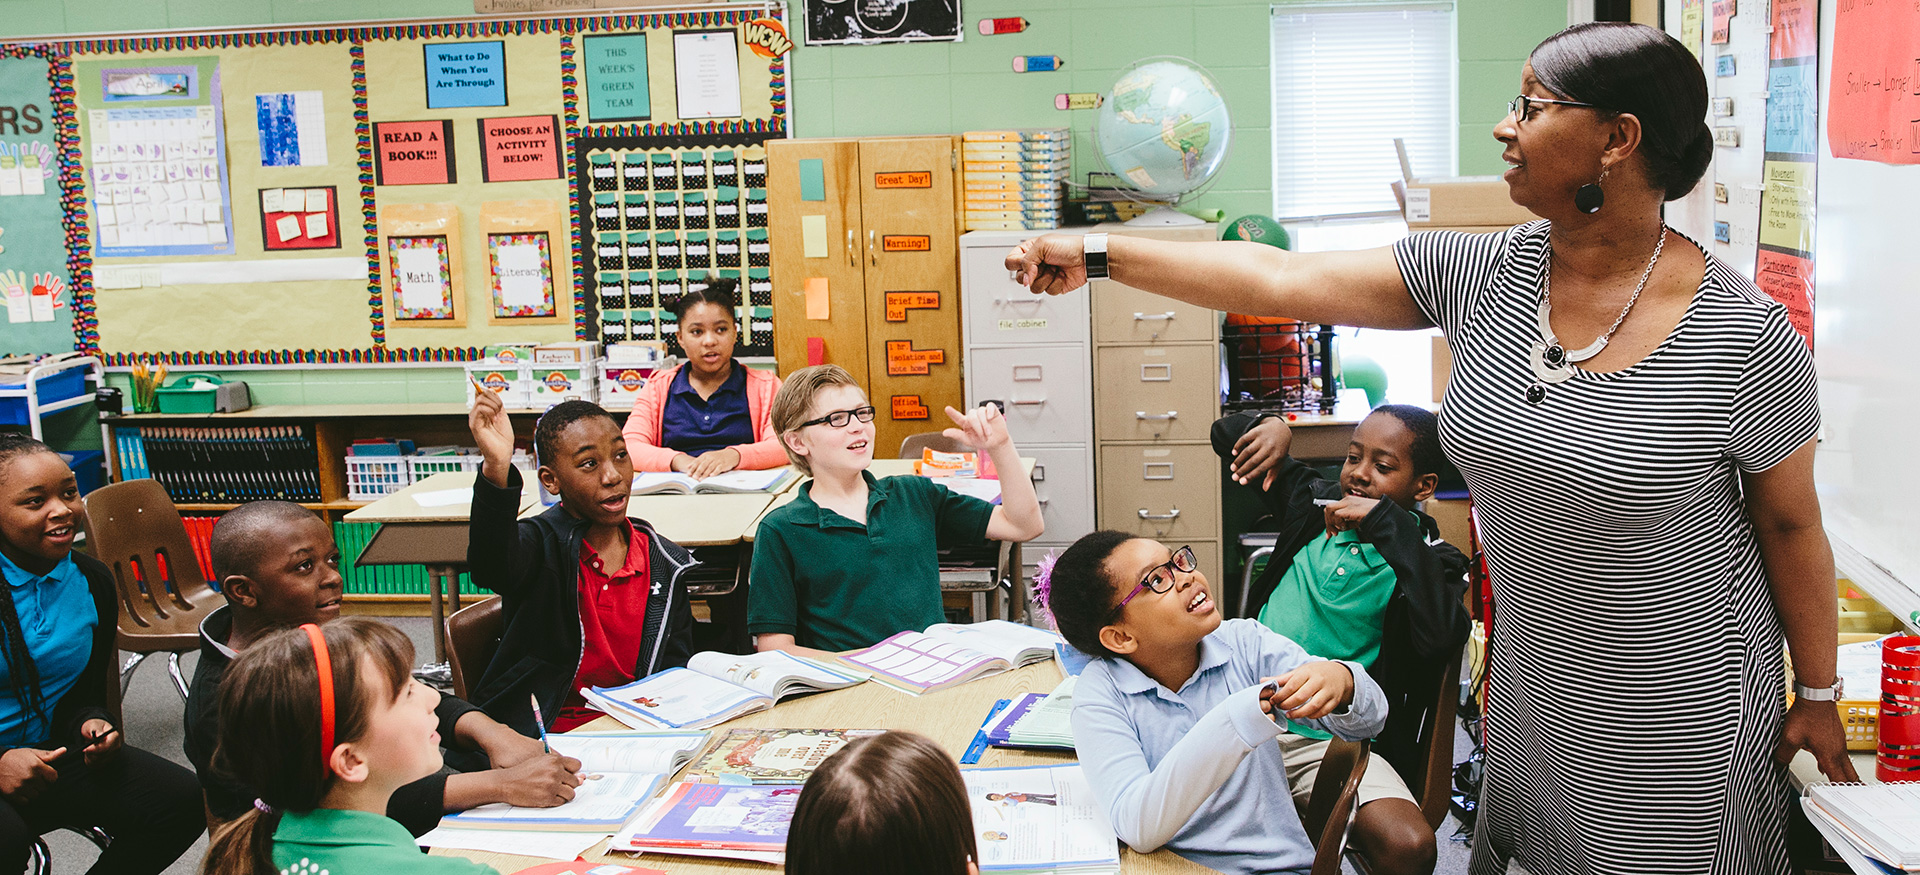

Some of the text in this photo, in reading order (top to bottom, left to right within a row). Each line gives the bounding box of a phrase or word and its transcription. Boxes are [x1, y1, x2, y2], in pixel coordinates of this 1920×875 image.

[744, 21, 793, 57] WOW
[438, 53, 463, 62] What
[477, 52, 490, 61] Do
[605, 48, 627, 57] THIS
[441, 66, 489, 75] When You
[598, 64, 635, 74] WEEK'S
[136, 77, 164, 92] April
[436, 78, 495, 88] Are Through
[601, 81, 635, 91] GREEN
[1845, 72, 1870, 96] Smaller
[1884, 66, 1911, 101] Larger
[605, 98, 634, 108] TEAM
[490, 126, 550, 137] CHOOSE AN
[384, 131, 439, 143] READ A
[1880, 129, 1903, 151] Smaller
[496, 140, 547, 150] ACTIVITY
[388, 150, 437, 161] BOOK!!!
[503, 153, 543, 163] BELOW!
[1771, 167, 1794, 179] Movement
[877, 174, 929, 186] Great Day!
[1780, 197, 1789, 205] with
[1786, 210, 1796, 220] Move
[1776, 219, 1787, 230] Room
[885, 238, 927, 250] Warning!
[1763, 257, 1798, 275] Participation
[407, 272, 434, 284] Math
[500, 268, 542, 279] Literacy
[1765, 276, 1801, 291] Answer Questions
[1776, 289, 1788, 300] Called
[888, 295, 936, 306] Brief Time
[888, 311, 904, 319] Out
[1000, 320, 1046, 329] file cabinet
[1797, 320, 1810, 333] Ideas
[896, 342, 910, 351] hr.
[890, 352, 942, 362] isolation and
[890, 364, 927, 373] note home
[893, 398, 919, 407] Office
[894, 409, 926, 418] Referral
